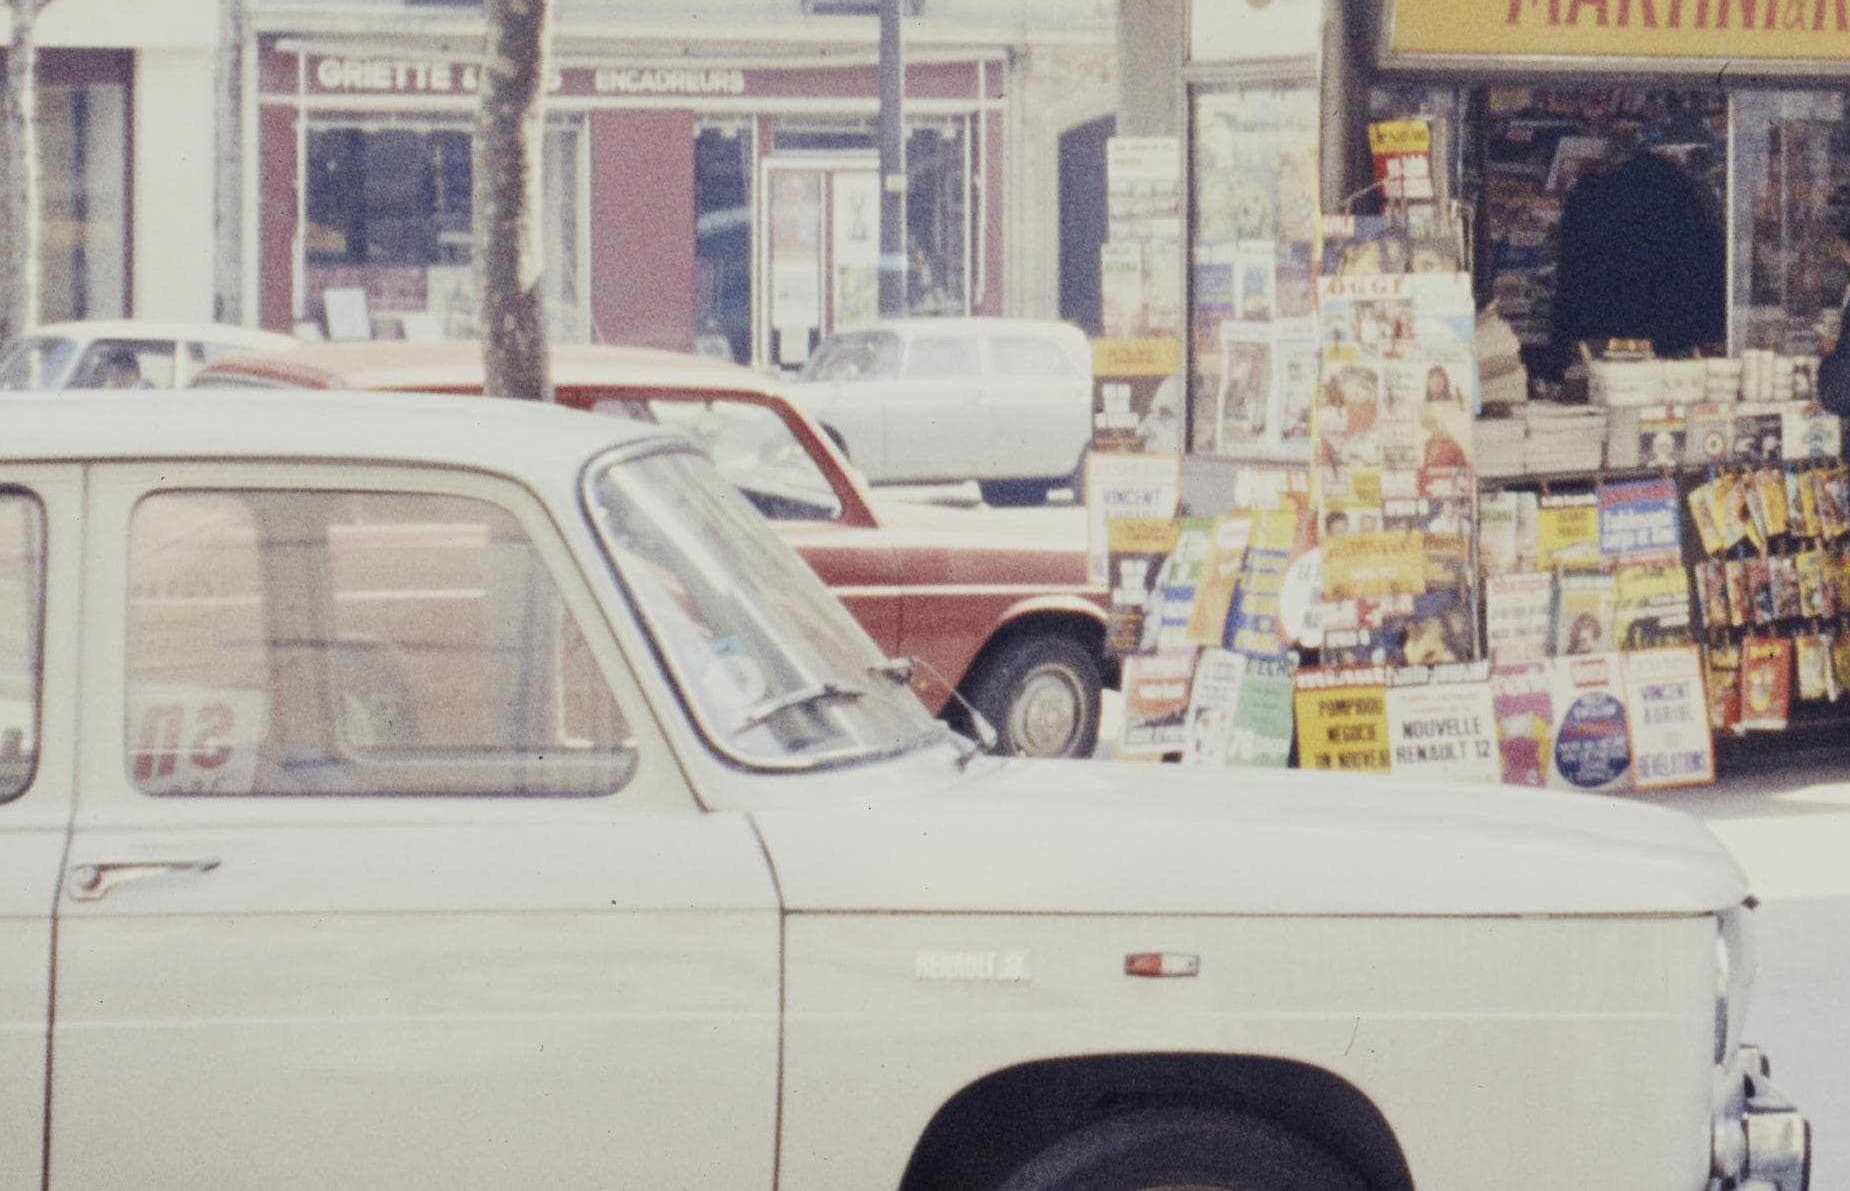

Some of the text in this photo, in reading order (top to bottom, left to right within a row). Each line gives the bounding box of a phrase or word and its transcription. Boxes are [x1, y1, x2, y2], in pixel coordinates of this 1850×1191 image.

[317, 59, 453, 91] GRIETTE
[593, 68, 746, 94] ENCADREURS
[1401, 717, 1482, 740] NOUVELLE
[1395, 739, 1492, 765] RENAULT 12
